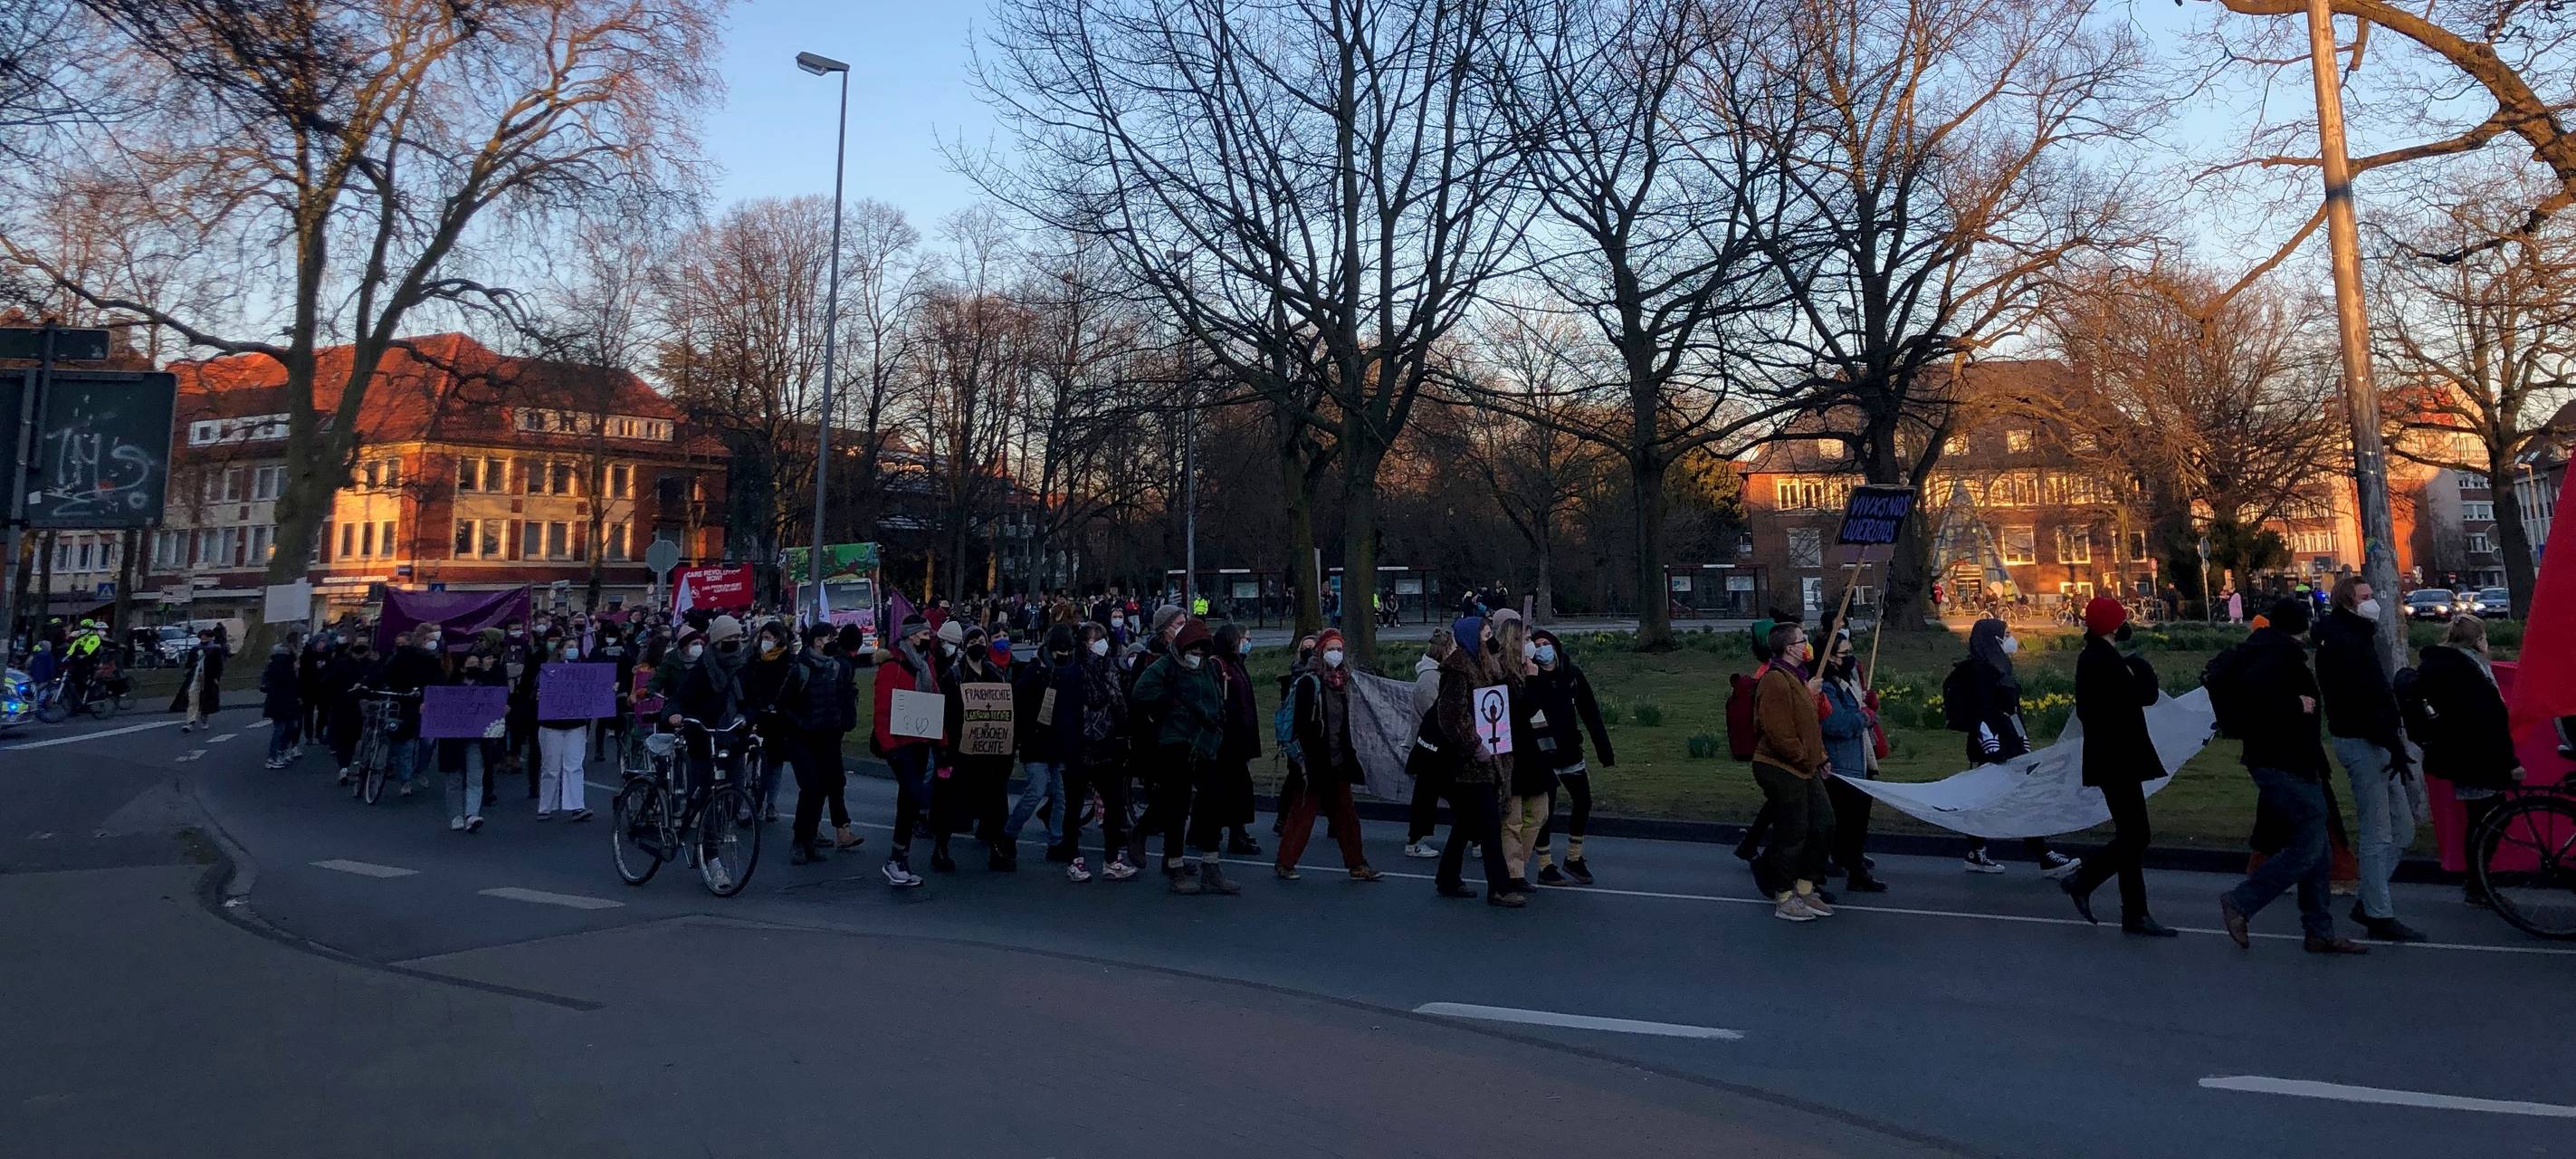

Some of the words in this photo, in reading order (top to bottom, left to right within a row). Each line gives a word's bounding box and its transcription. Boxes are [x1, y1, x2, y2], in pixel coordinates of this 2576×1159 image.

[1852, 495, 1889, 517] VIVXS
[1886, 494, 1911, 517] NOS
[1843, 519, 1896, 542] QUEREMOS
[964, 688, 1011, 703] FRAUENRECHTE
[968, 727, 1008, 740] MENSCHEN
[972, 741, 1004, 753] RECHTE
